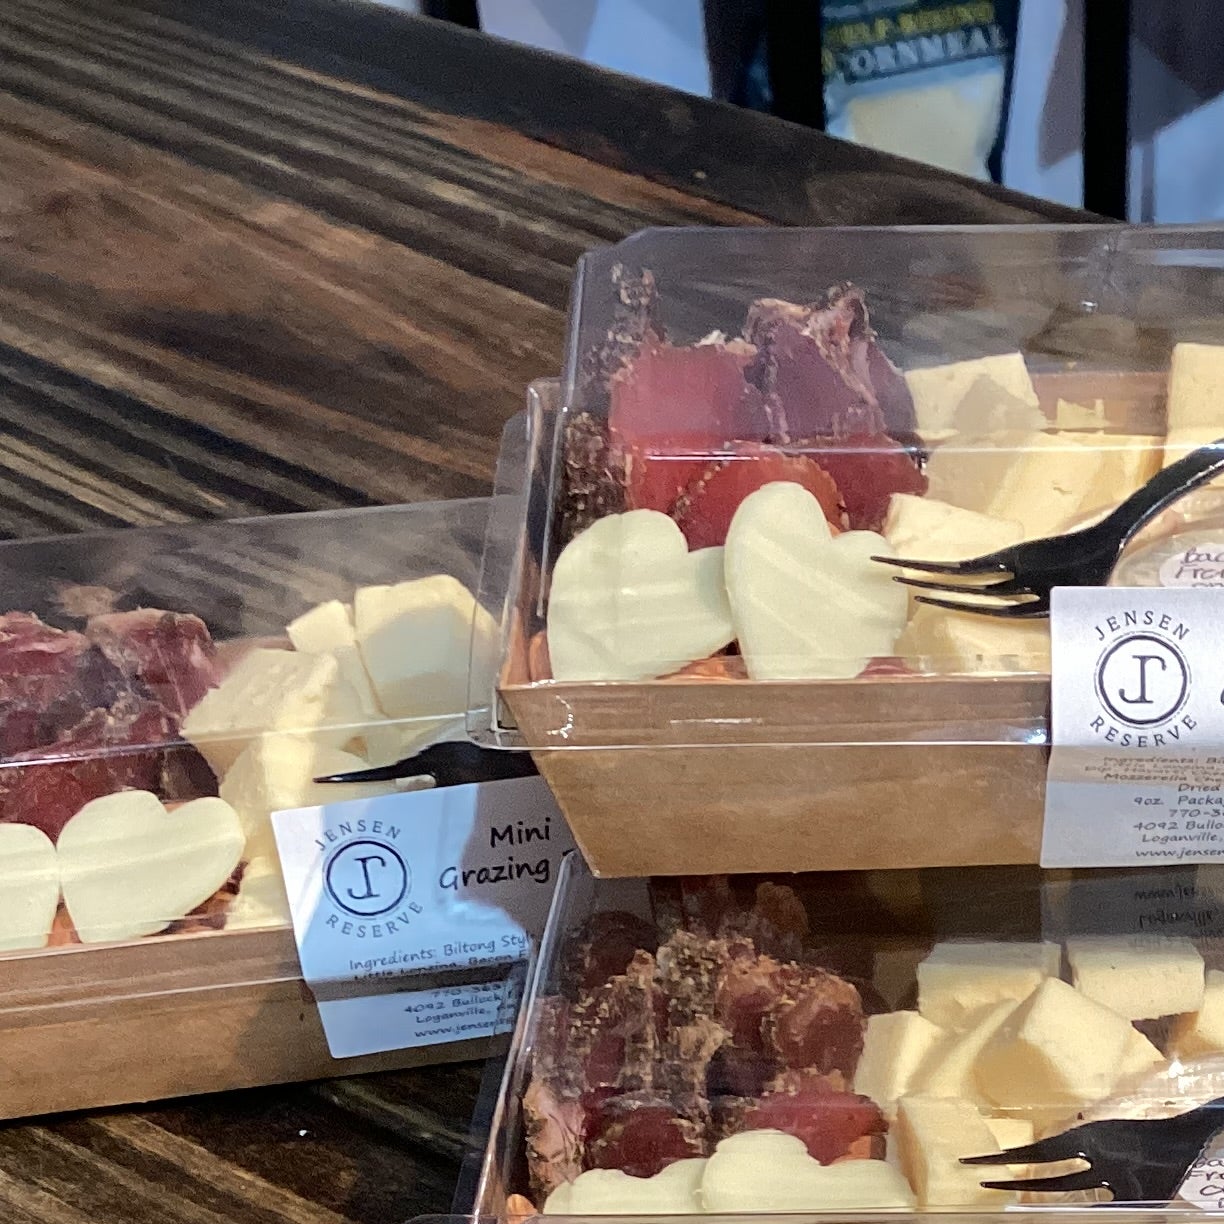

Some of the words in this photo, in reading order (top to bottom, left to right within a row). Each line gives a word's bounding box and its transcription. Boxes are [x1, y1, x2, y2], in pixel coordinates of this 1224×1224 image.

[1093, 610, 1190, 642] JENSEN
[1089, 714, 1198, 748] RESERVE
[1178, 783, 1220, 792] Dried
[314, 819, 402, 851] JENSEN
[489, 817, 551, 848] Mini
[1133, 821, 1179, 831] 4092
[1142, 832, 1224, 844] Loganville,
[439, 857, 551, 890] Grazing
[325, 900, 425, 938] RESERVE
[443, 940, 496, 957] Biltong
[404, 1002, 447, 1014] 4092
